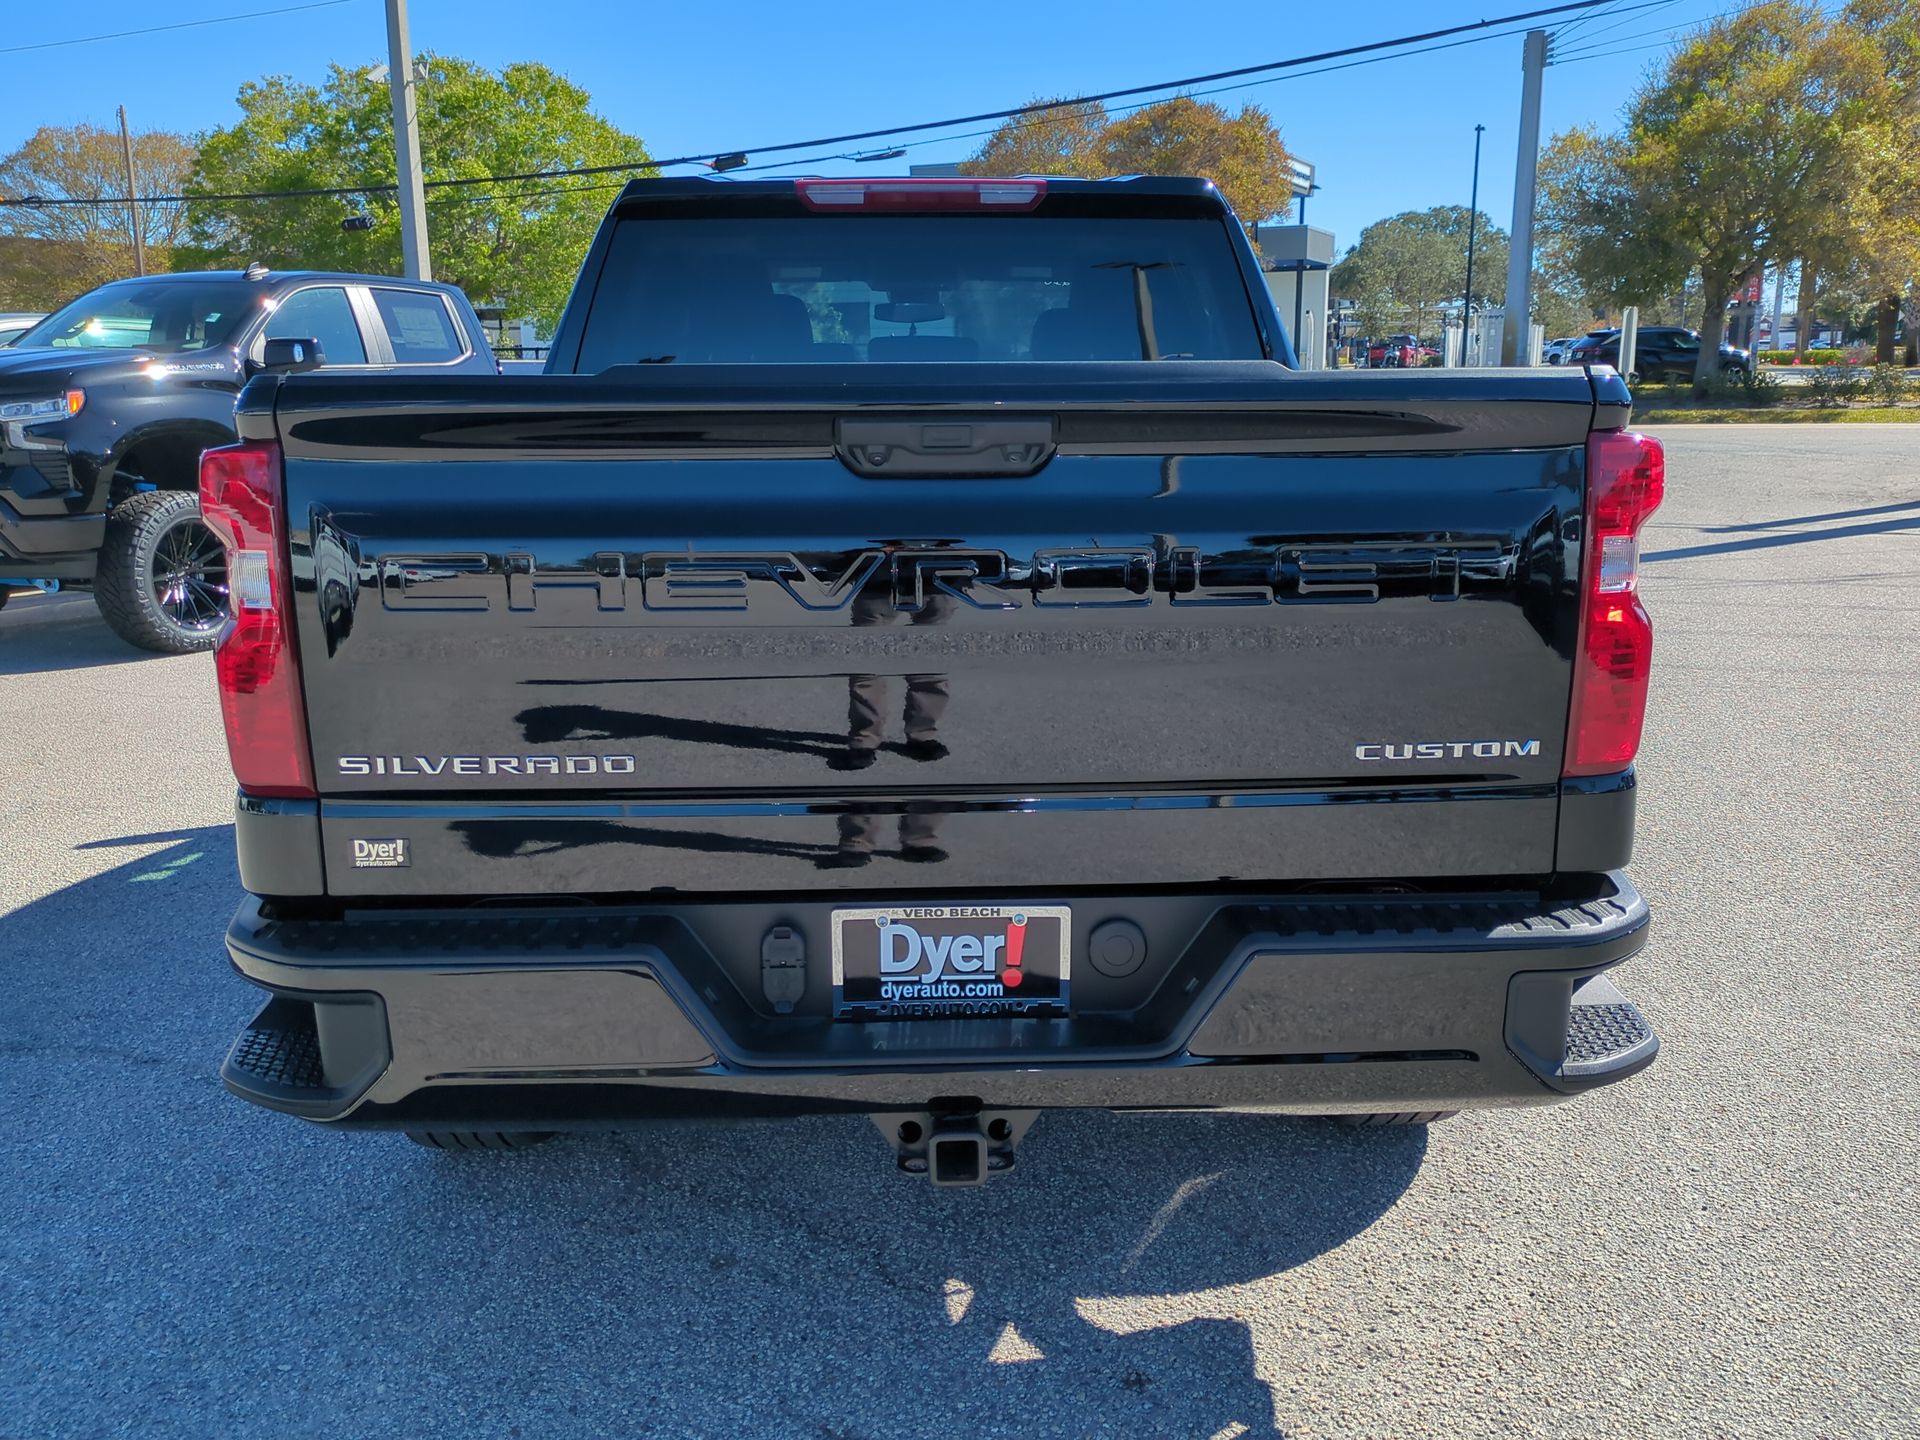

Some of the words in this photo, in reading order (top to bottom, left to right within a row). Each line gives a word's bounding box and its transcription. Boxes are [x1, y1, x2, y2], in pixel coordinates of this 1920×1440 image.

[379, 542, 1503, 613] CHEVROLET
[1355, 740, 1541, 760] CUSTOM
[339, 756, 635, 775] SILVERADO
[354, 839, 404, 862] Dyer!
[356, 860, 398, 868] dyerauto.com
[903, 908, 944, 918] VERO
[949, 907, 1001, 918] BEACH
[880, 923, 1027, 988] Dyer!
[880, 983, 1003, 1001] dyerauto.com
[889, 1002, 1014, 1016] DYERAUTO.COM
